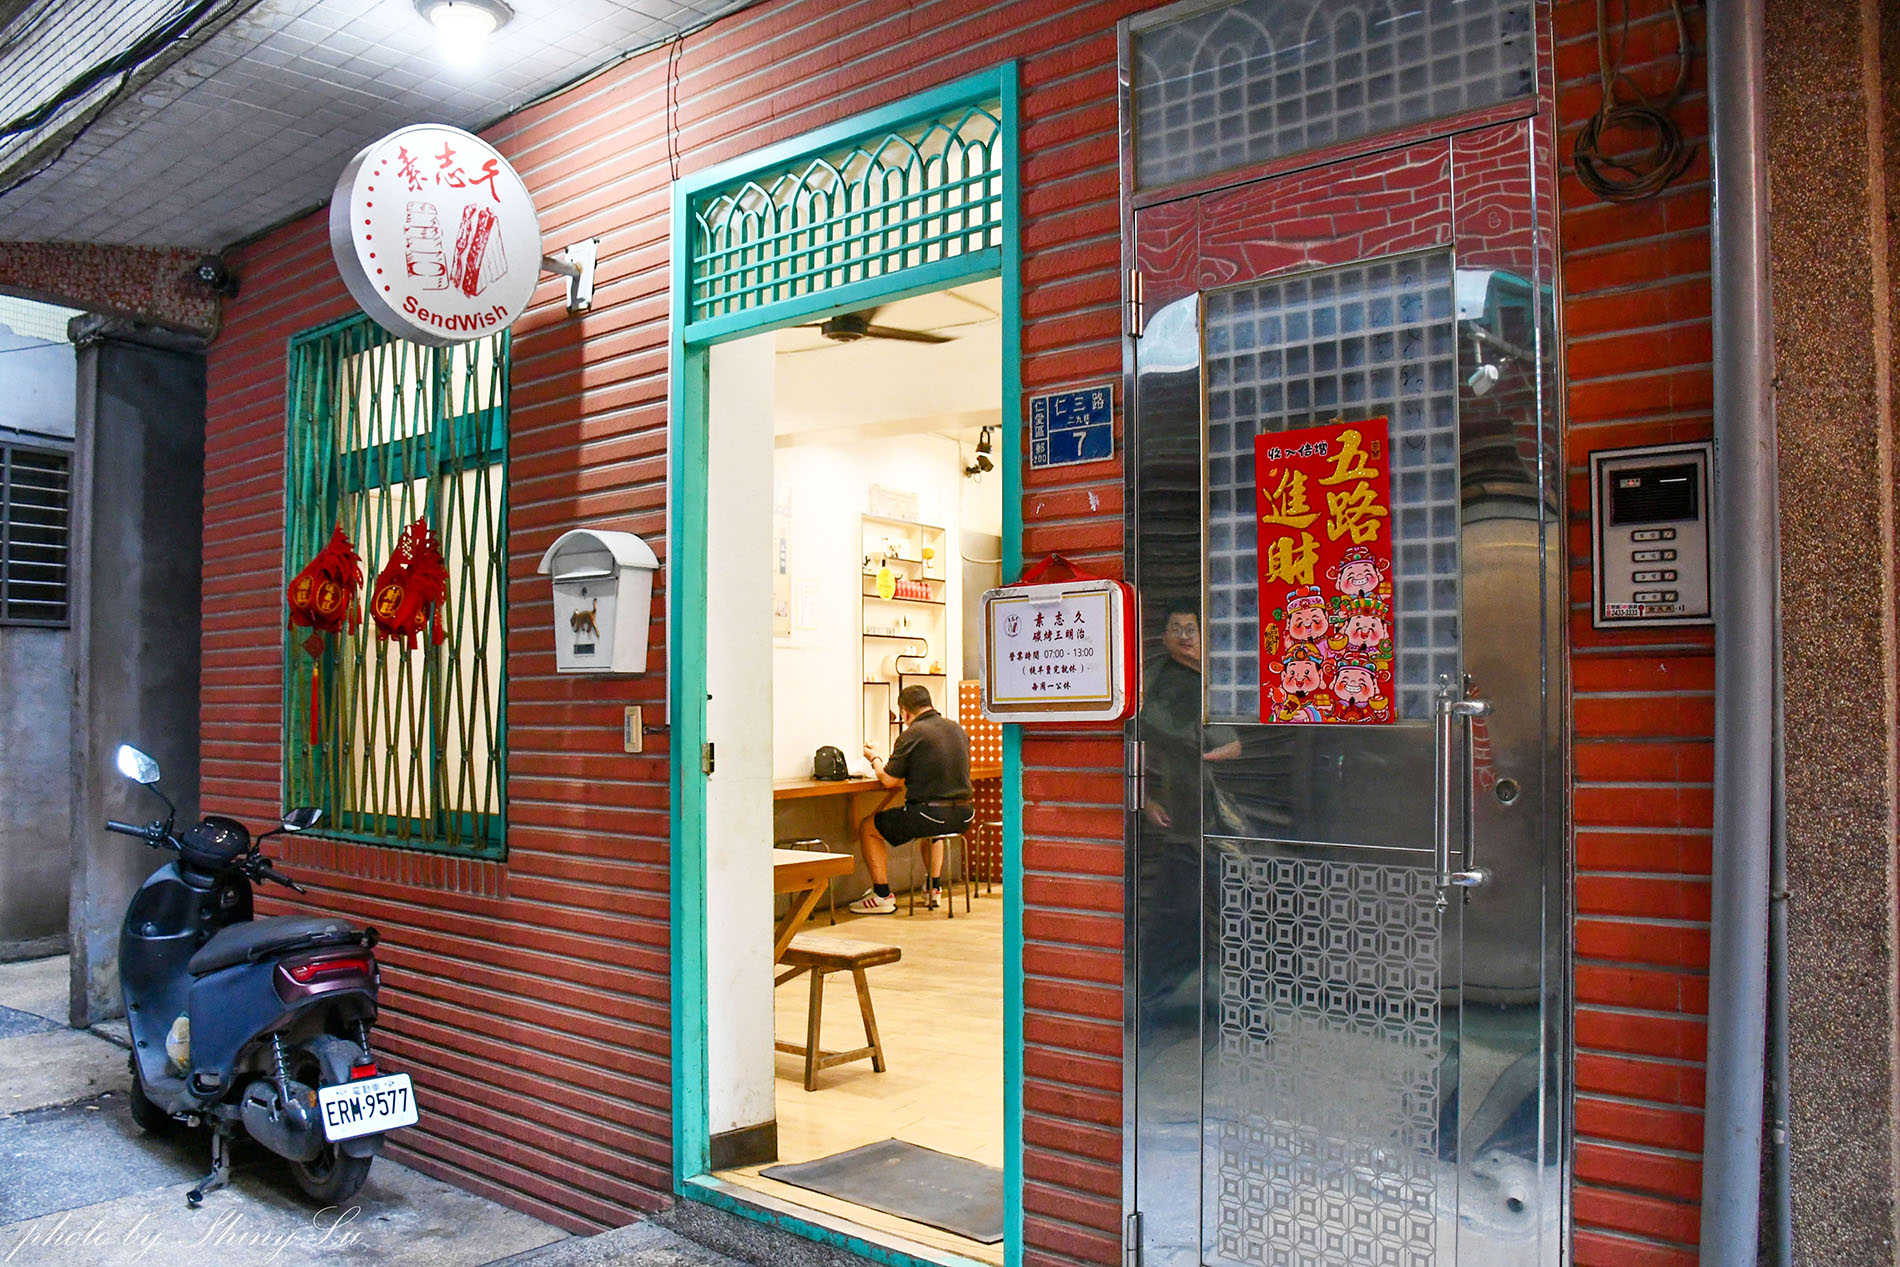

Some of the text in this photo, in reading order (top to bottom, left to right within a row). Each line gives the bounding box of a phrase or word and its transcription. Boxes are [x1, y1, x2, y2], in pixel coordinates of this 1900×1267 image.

[402, 295, 508, 331] SendWish
[1054, 392, 1104, 416] 仁三路
[1073, 431, 1087, 457] 7
[1267, 440, 1328, 461] 收入倍增
[1033, 454, 1047, 464] 200
[1318, 429, 1388, 545] 五路
[1262, 468, 1322, 585] 進財
[1034, 610, 1085, 628] 素志久
[1032, 628, 1085, 642] 碳烤三明治
[1009, 650, 1039, 661] 營業時間
[1043, 649, 1065, 659] 07:00
[1073, 647, 1094, 657] 13:00
